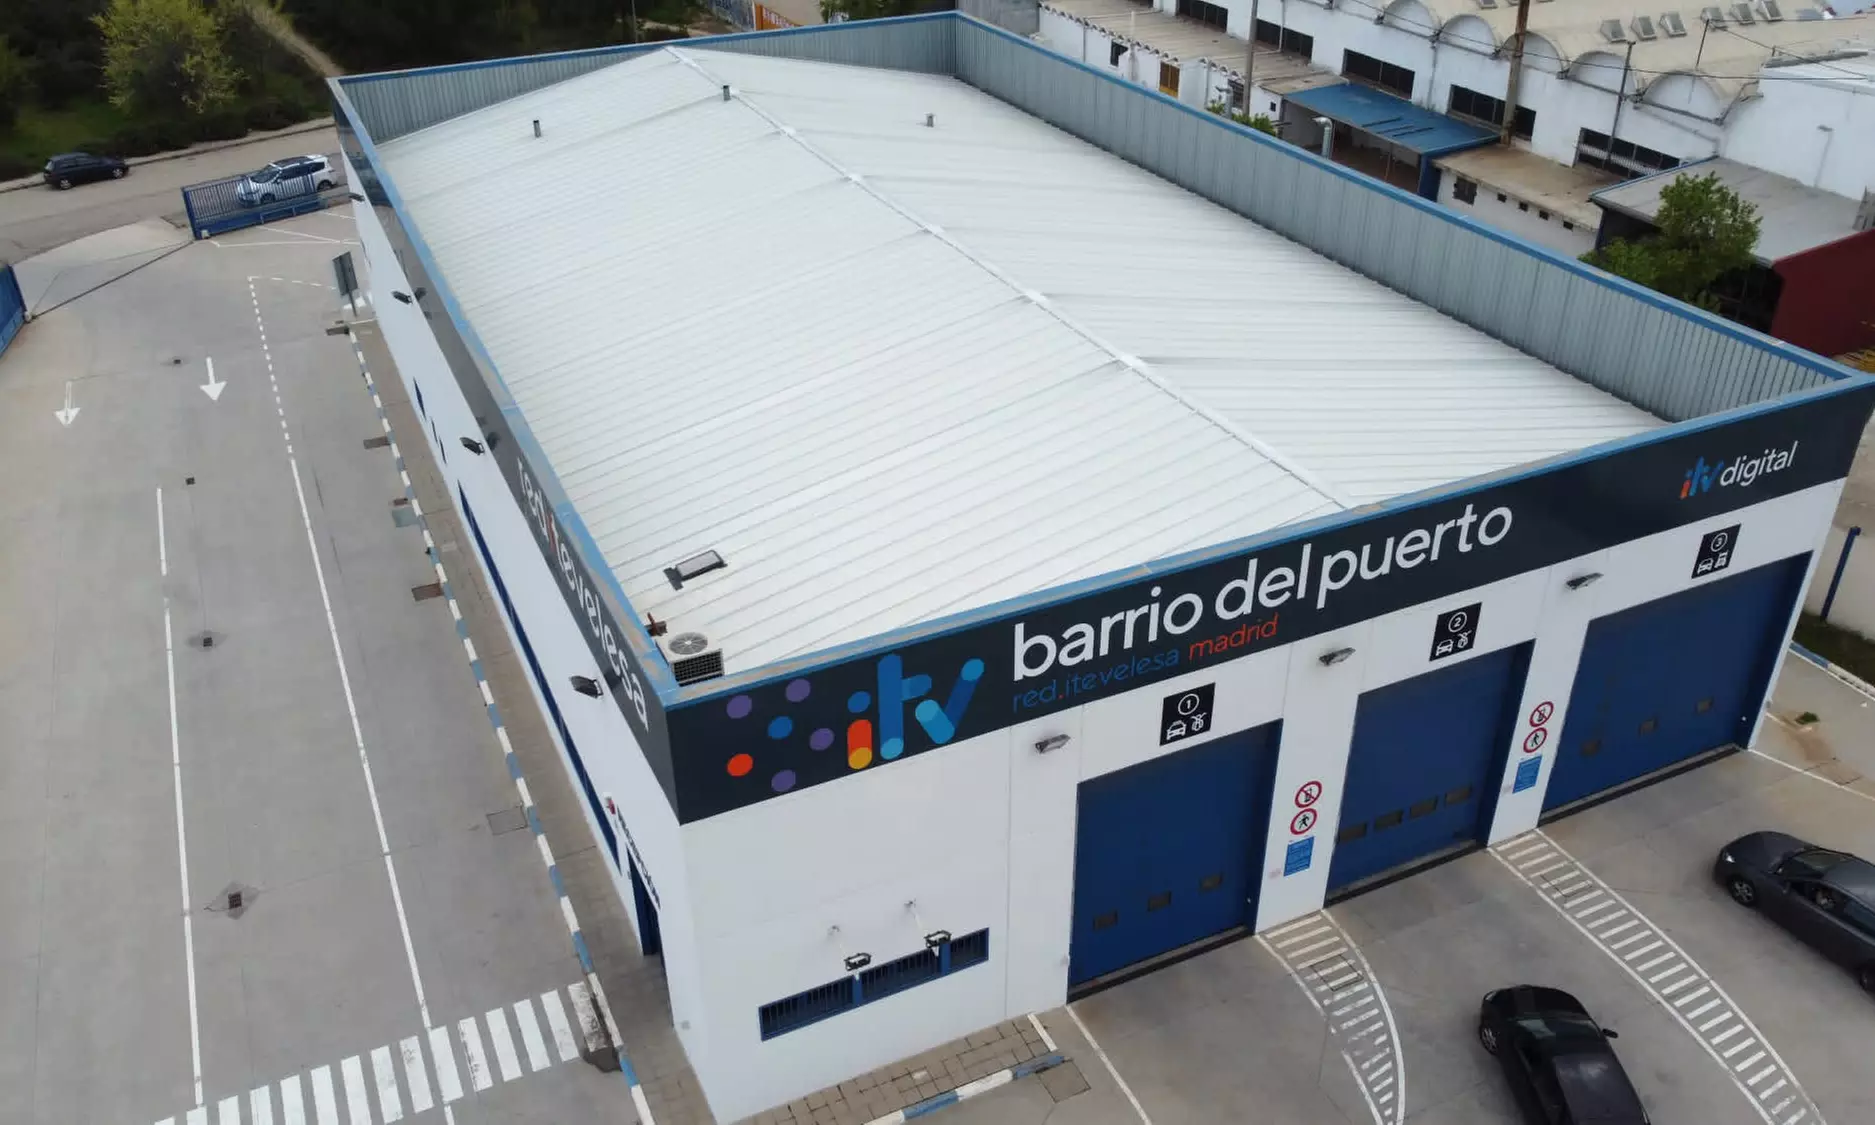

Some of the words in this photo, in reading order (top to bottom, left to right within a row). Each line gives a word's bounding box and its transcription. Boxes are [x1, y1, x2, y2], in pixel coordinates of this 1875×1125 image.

[1680, 455, 1725, 499] itv
[1719, 440, 1799, 487] digital
[1013, 586, 1204, 682] barrio
[1215, 542, 1312, 620] del
[1317, 503, 1513, 610] puerto
[1453, 616, 1462, 628] 2
[1188, 611, 1279, 661] madrid
[845, 653, 986, 770] itv
